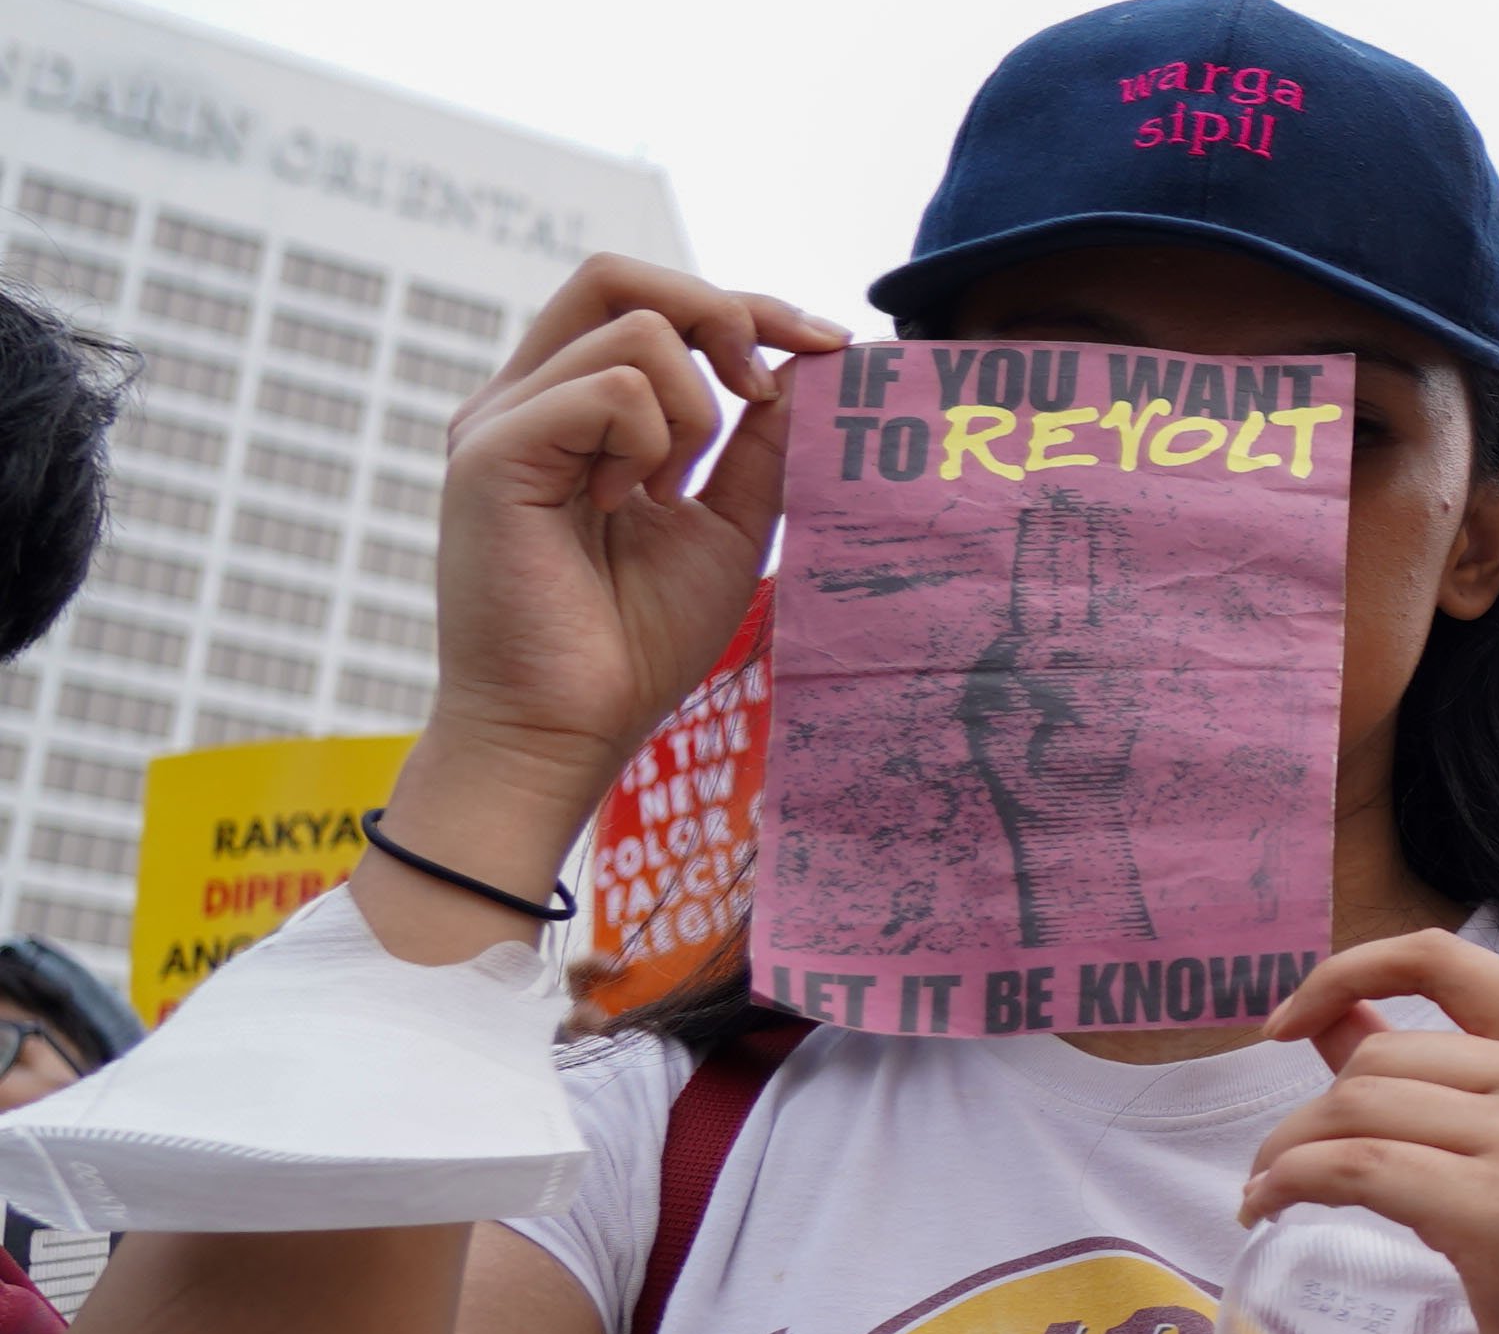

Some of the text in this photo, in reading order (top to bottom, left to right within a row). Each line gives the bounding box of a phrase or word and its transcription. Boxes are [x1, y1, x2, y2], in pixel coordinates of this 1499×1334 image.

[1120, 59, 1307, 112] warga
[1134, 102, 1275, 160] sipil
[837, 348, 1324, 423] IF YOU WANT
[835, 399, 1343, 483] TO REVOLT
[773, 966, 877, 1029] LET
[898, 974, 964, 1034] IT
[996, 966, 1059, 1033] BE
